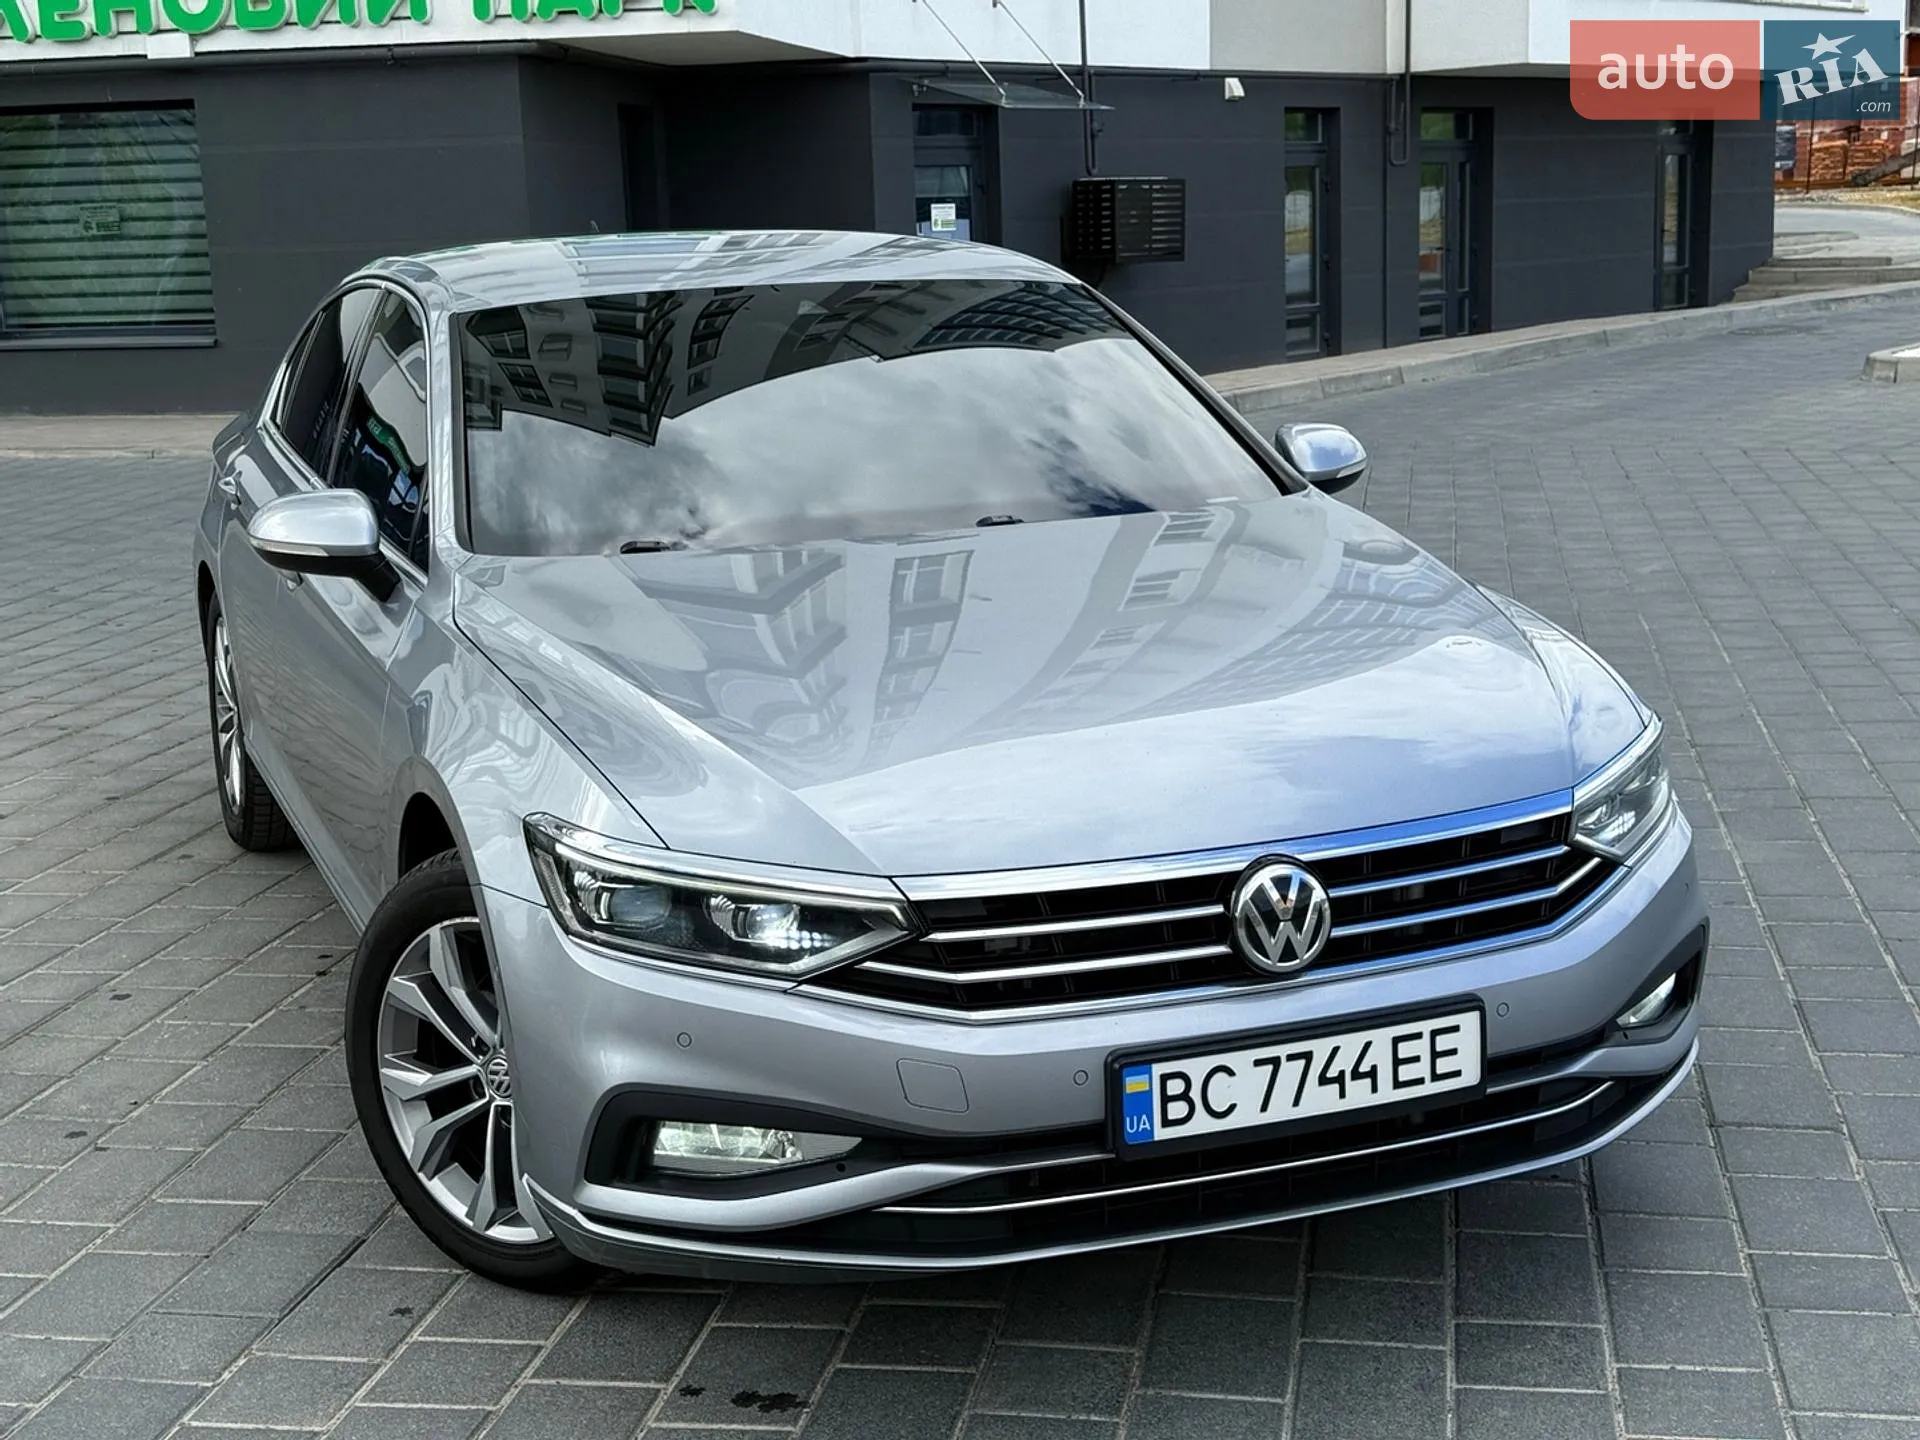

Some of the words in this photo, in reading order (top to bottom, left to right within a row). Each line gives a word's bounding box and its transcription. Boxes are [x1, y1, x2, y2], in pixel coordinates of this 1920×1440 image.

[1242, 870, 1322, 966] VW
[1125, 1113, 1152, 1133] UA
[1159, 1064, 1238, 1128] BC
[1253, 1040, 1379, 1114] 7744
[1392, 1024, 1462, 1090] EE
